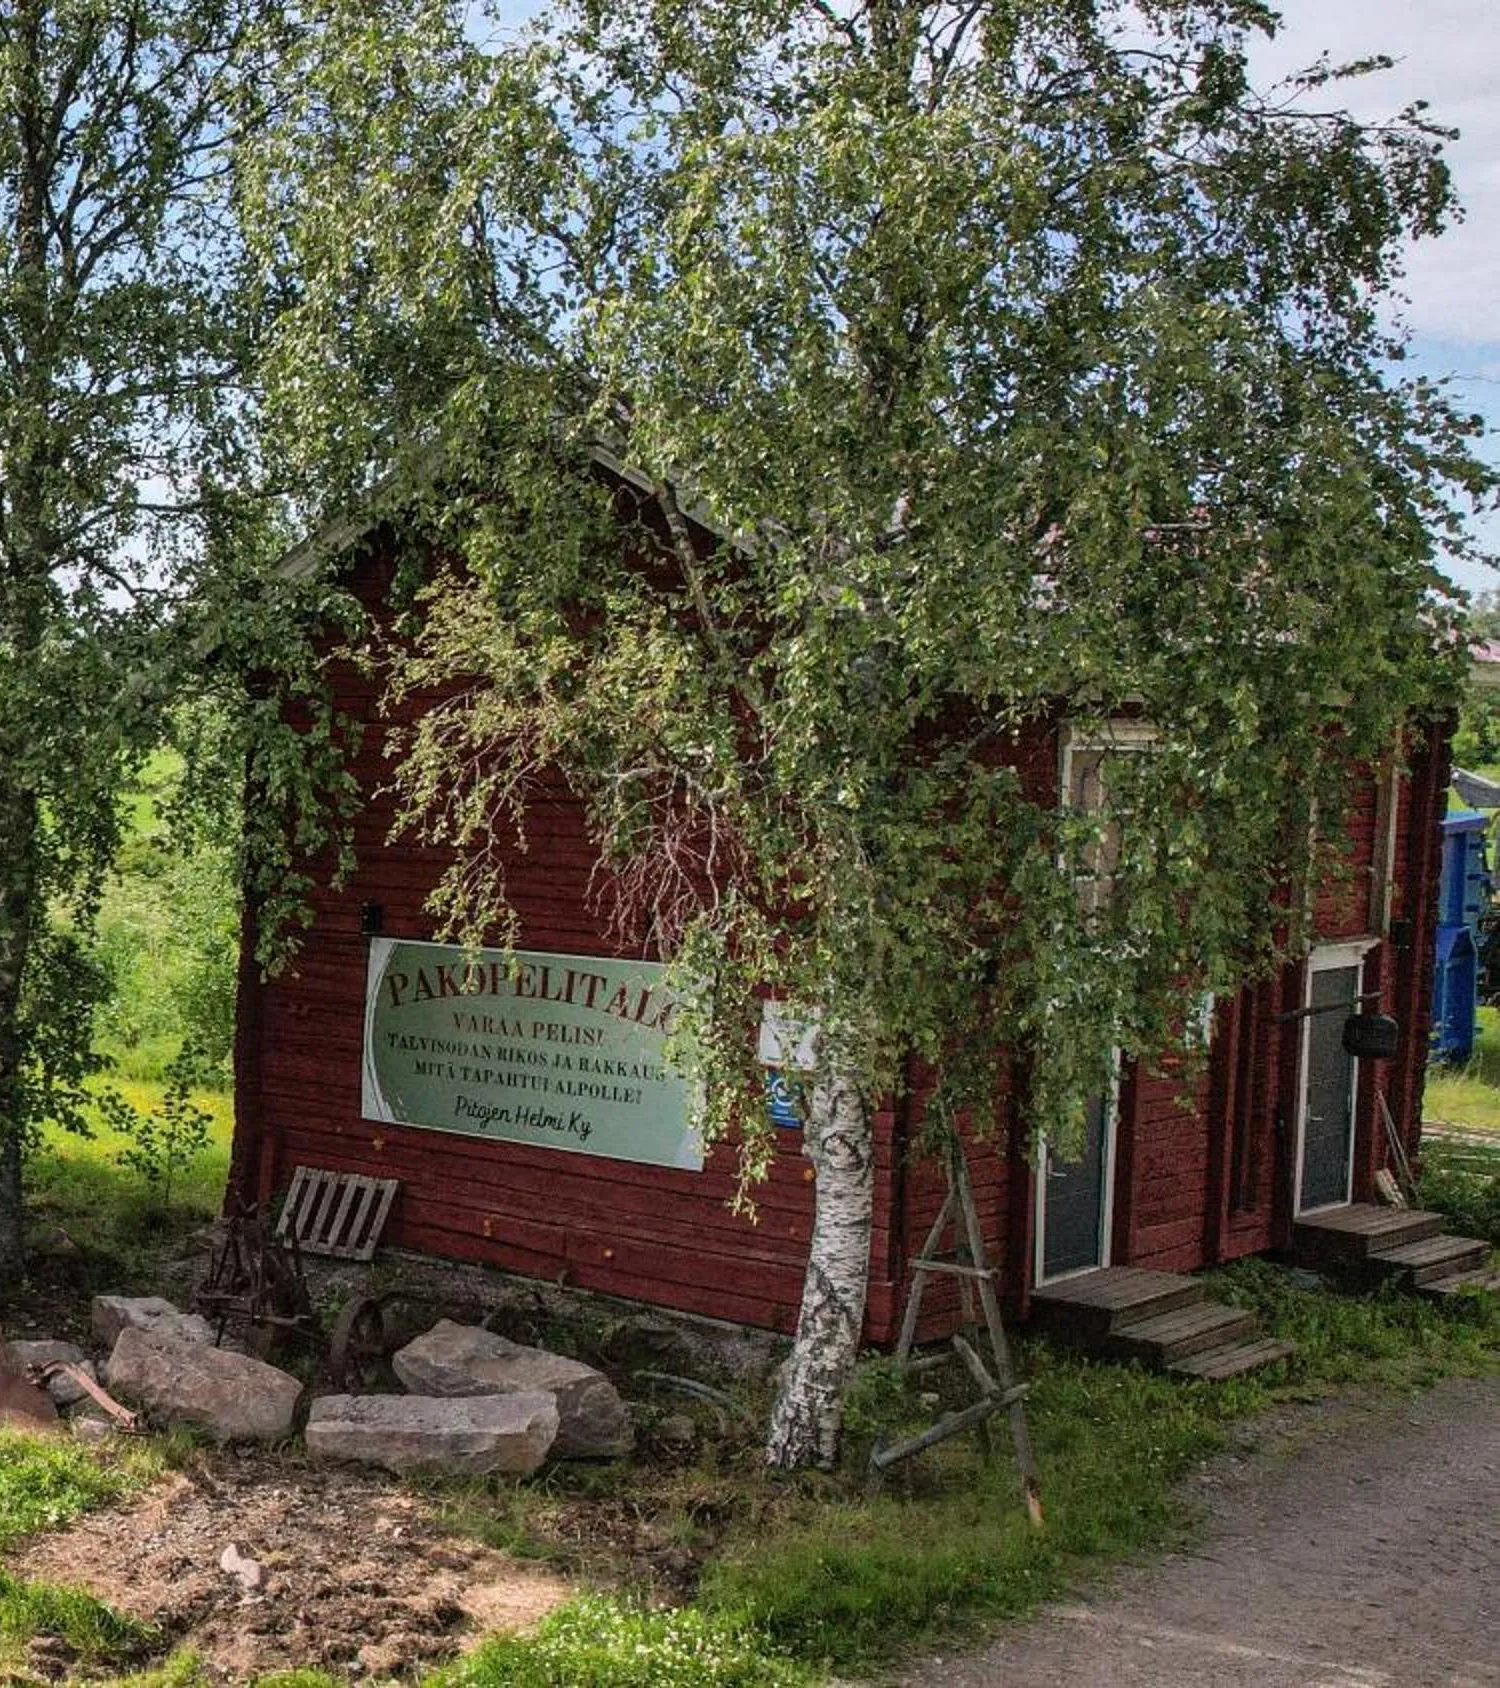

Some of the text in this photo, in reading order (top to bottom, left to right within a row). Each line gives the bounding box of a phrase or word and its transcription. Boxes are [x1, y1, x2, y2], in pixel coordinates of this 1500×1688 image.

[453, 1011, 524, 1038] VARAA
[387, 1031, 492, 1060] TALVISODAN
[552, 1054, 573, 1072] JA
[415, 1059, 455, 1080] MITÄ
[459, 1065, 549, 1091] TAPAHTUI
[454, 1094, 592, 1141] Pitojen Helmi Ky
